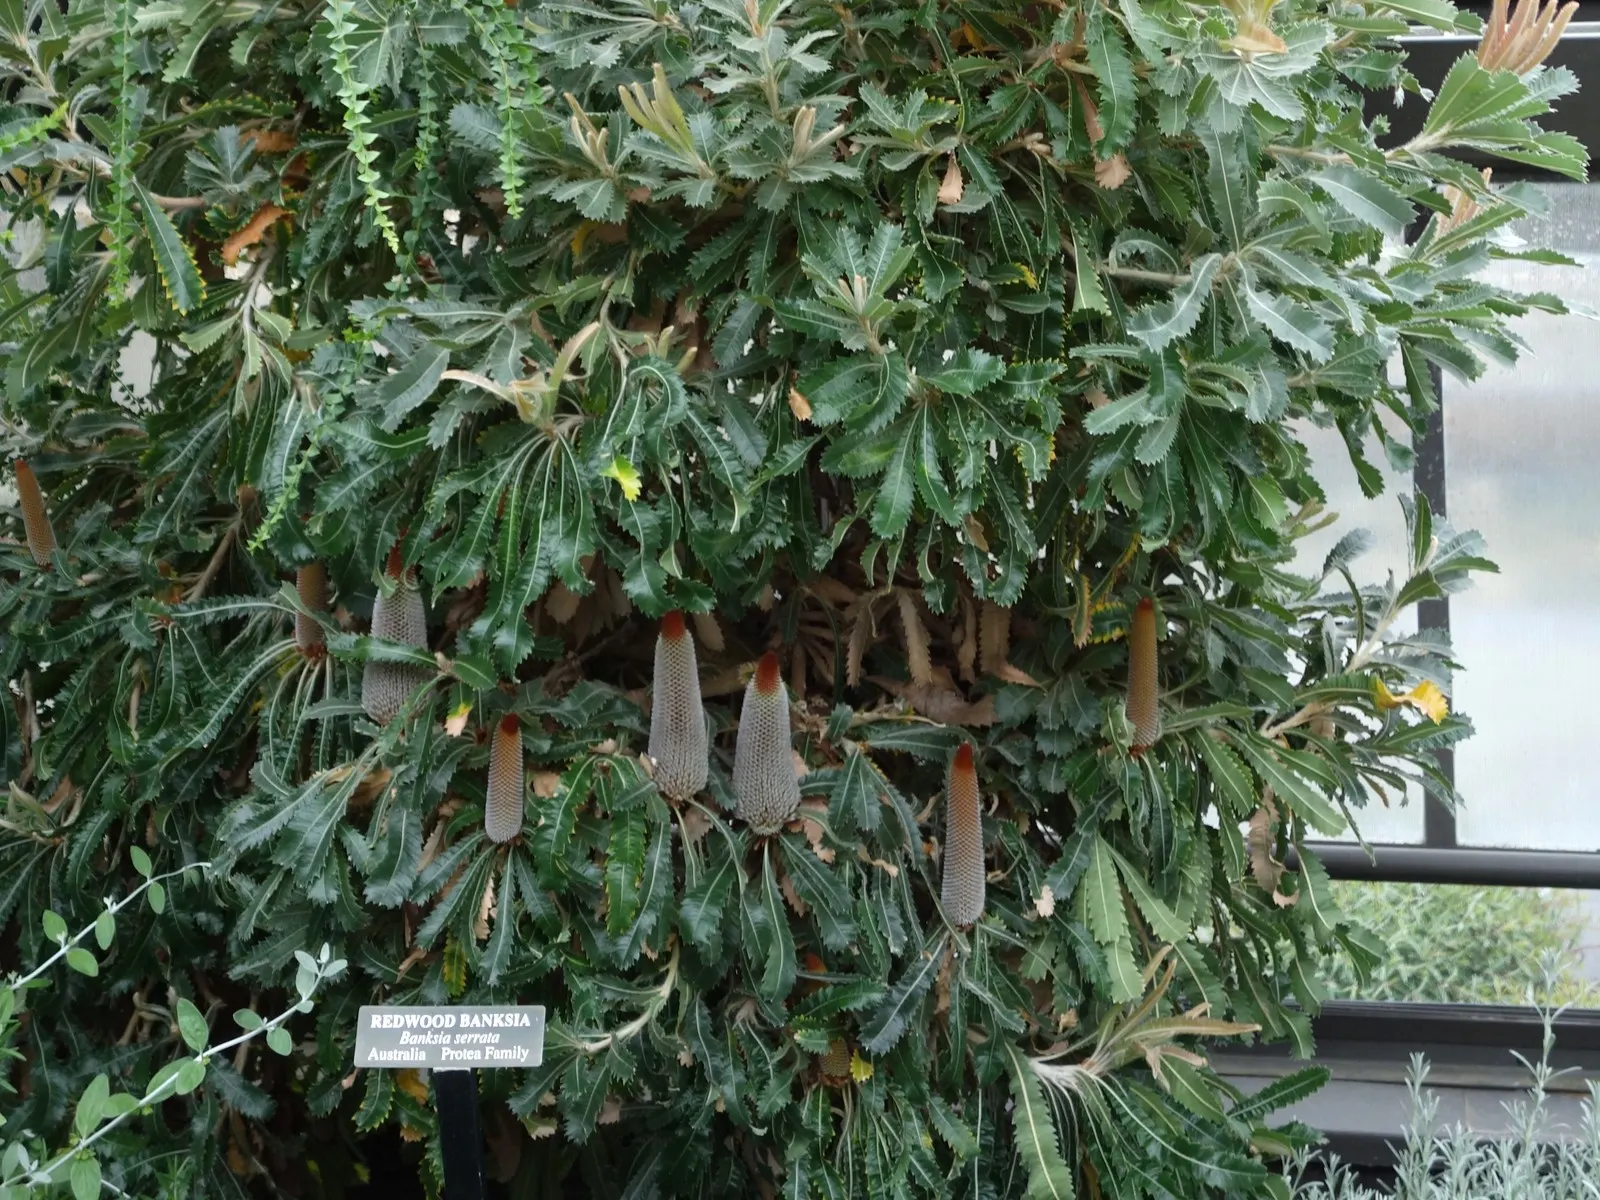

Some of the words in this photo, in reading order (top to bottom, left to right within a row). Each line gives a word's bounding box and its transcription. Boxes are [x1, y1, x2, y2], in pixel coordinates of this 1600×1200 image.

[371, 1014, 456, 1028] REDWOOD
[459, 1013, 531, 1027] BANKSIA
[399, 1031, 451, 1045] Banksia
[454, 1032, 500, 1044] serrata
[368, 1047, 426, 1061] Australia
[441, 1046, 481, 1060] Protea
[484, 1046, 529, 1062] Family
